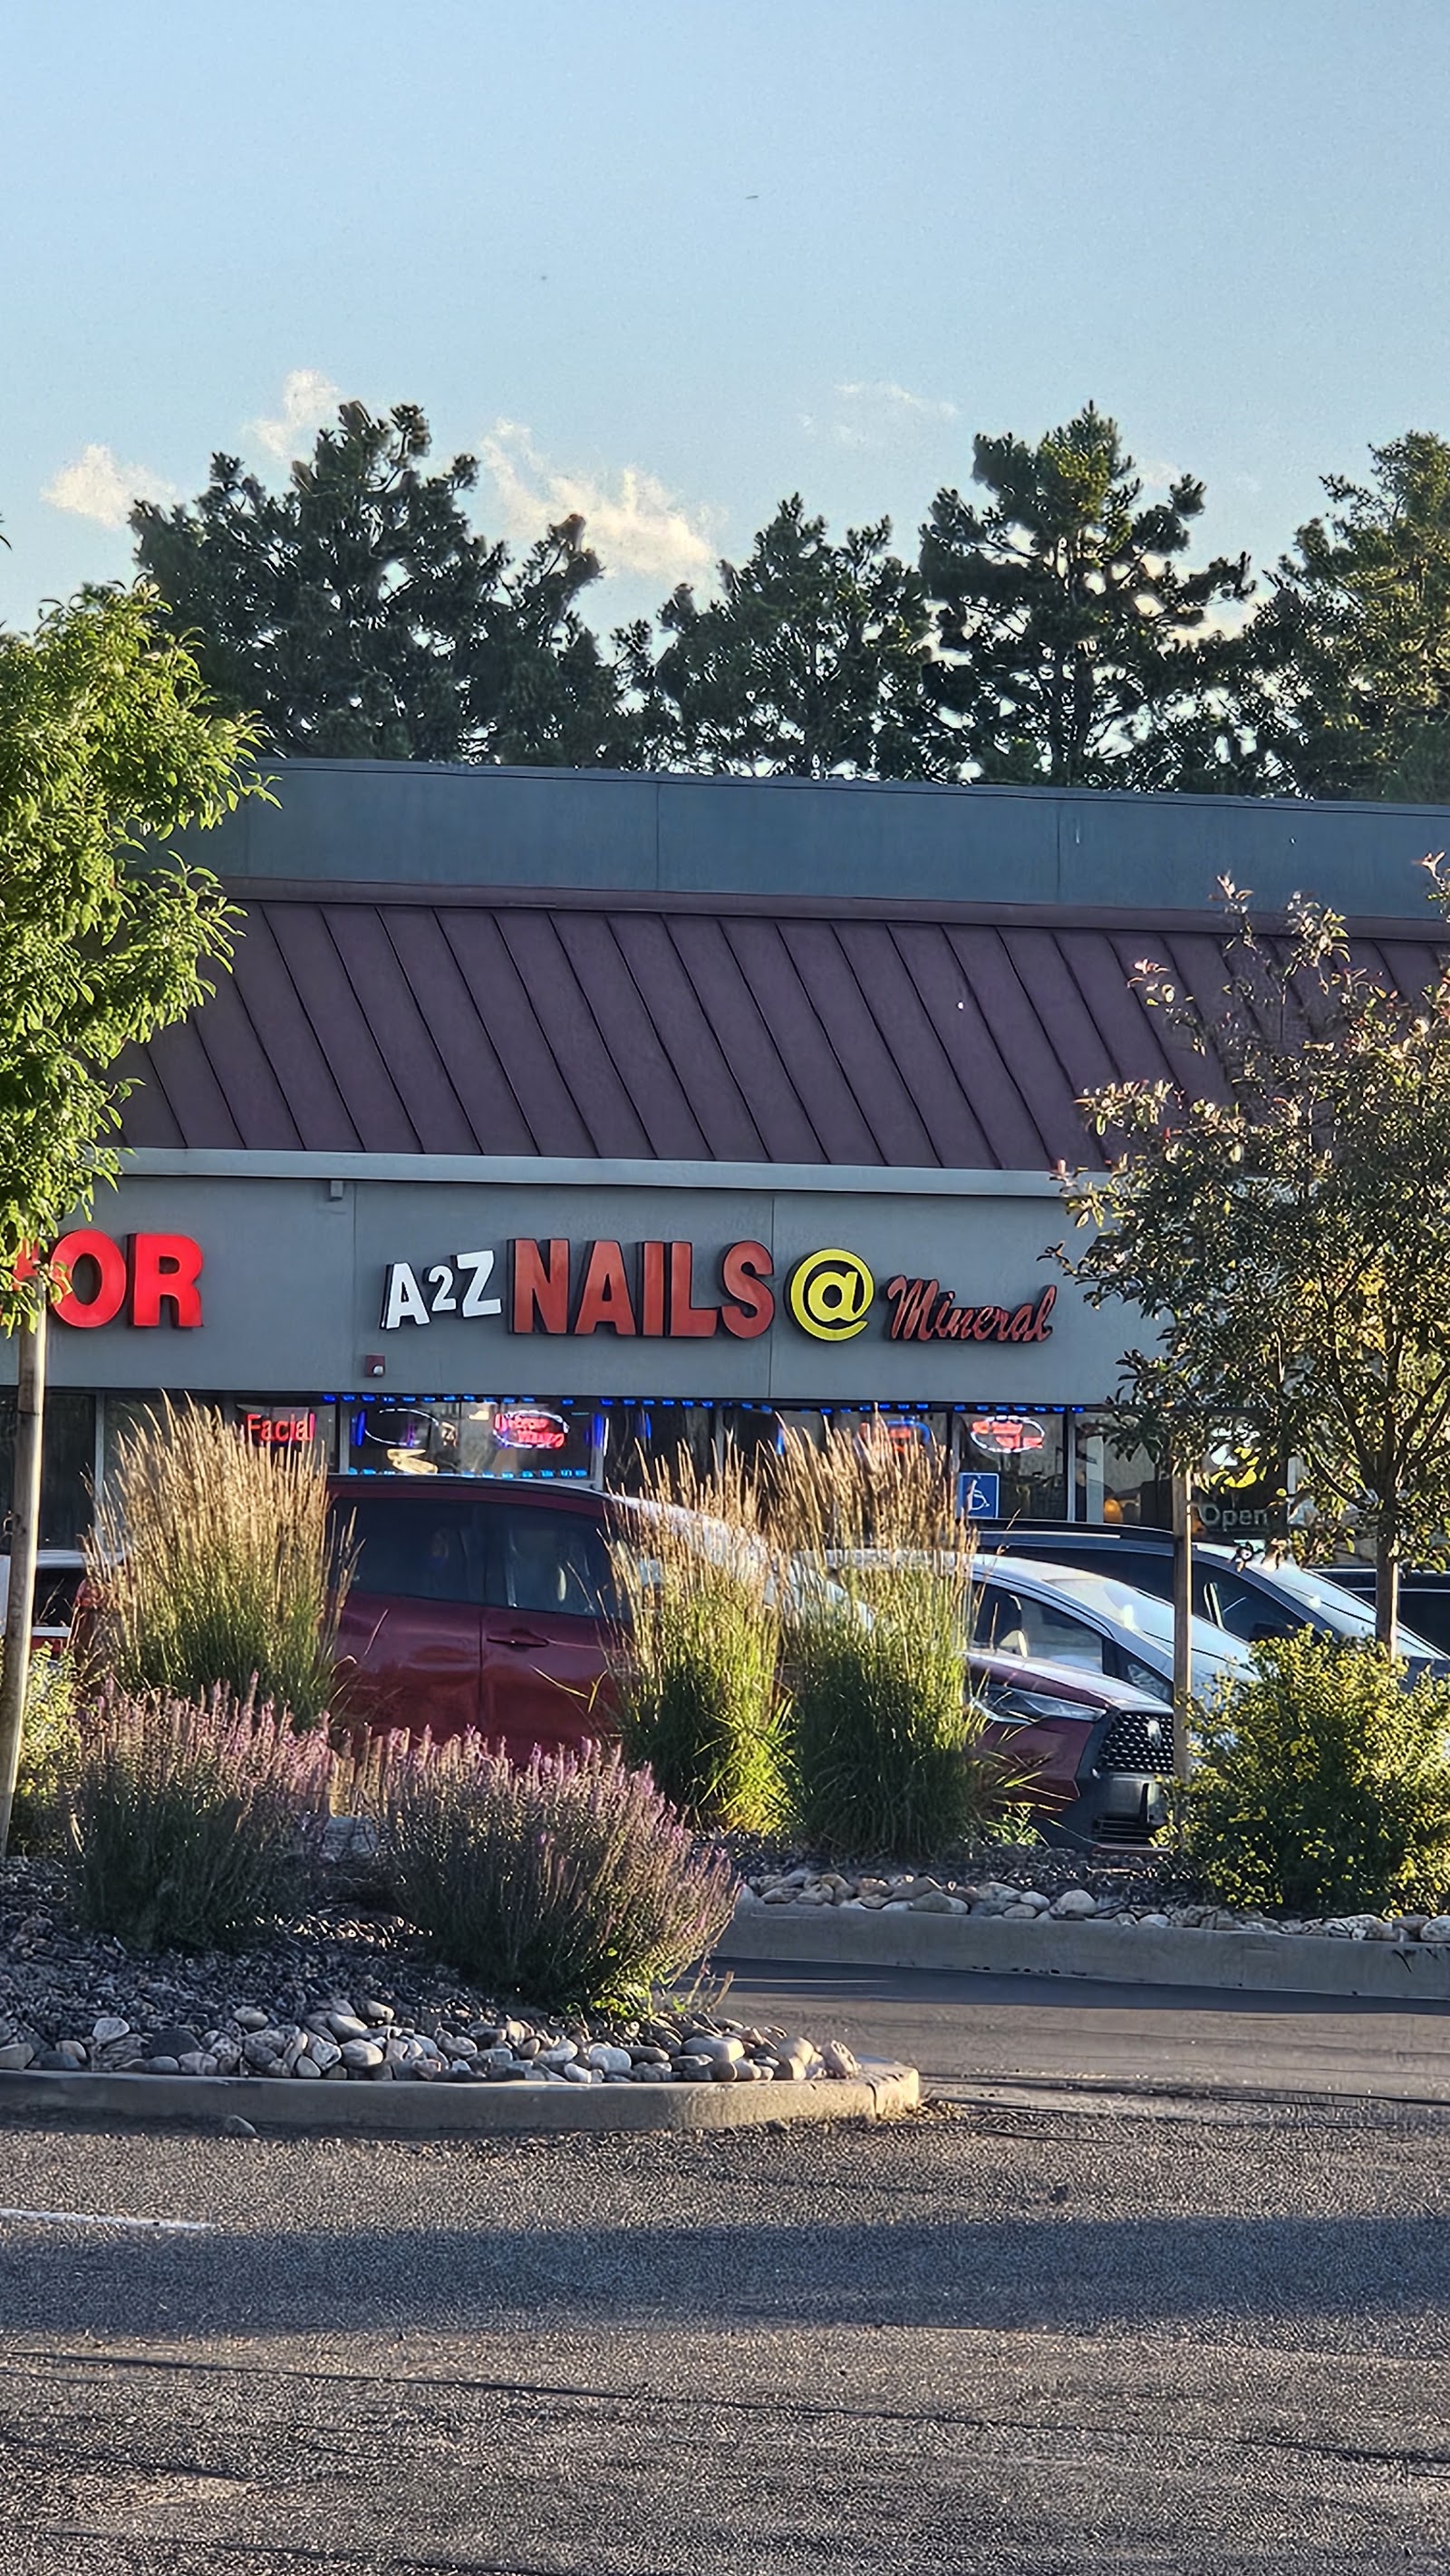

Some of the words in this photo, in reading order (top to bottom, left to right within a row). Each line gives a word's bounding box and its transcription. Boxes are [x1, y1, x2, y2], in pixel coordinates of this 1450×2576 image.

[381, 1249, 502, 1329] A2Z
[509, 1239, 776, 1340] NAILS
[786, 1248, 875, 1341] @
[886, 1273, 1058, 1342] Mineral
[246, 1412, 315, 1441] Facial
[1198, 1503, 1268, 1532] Open
